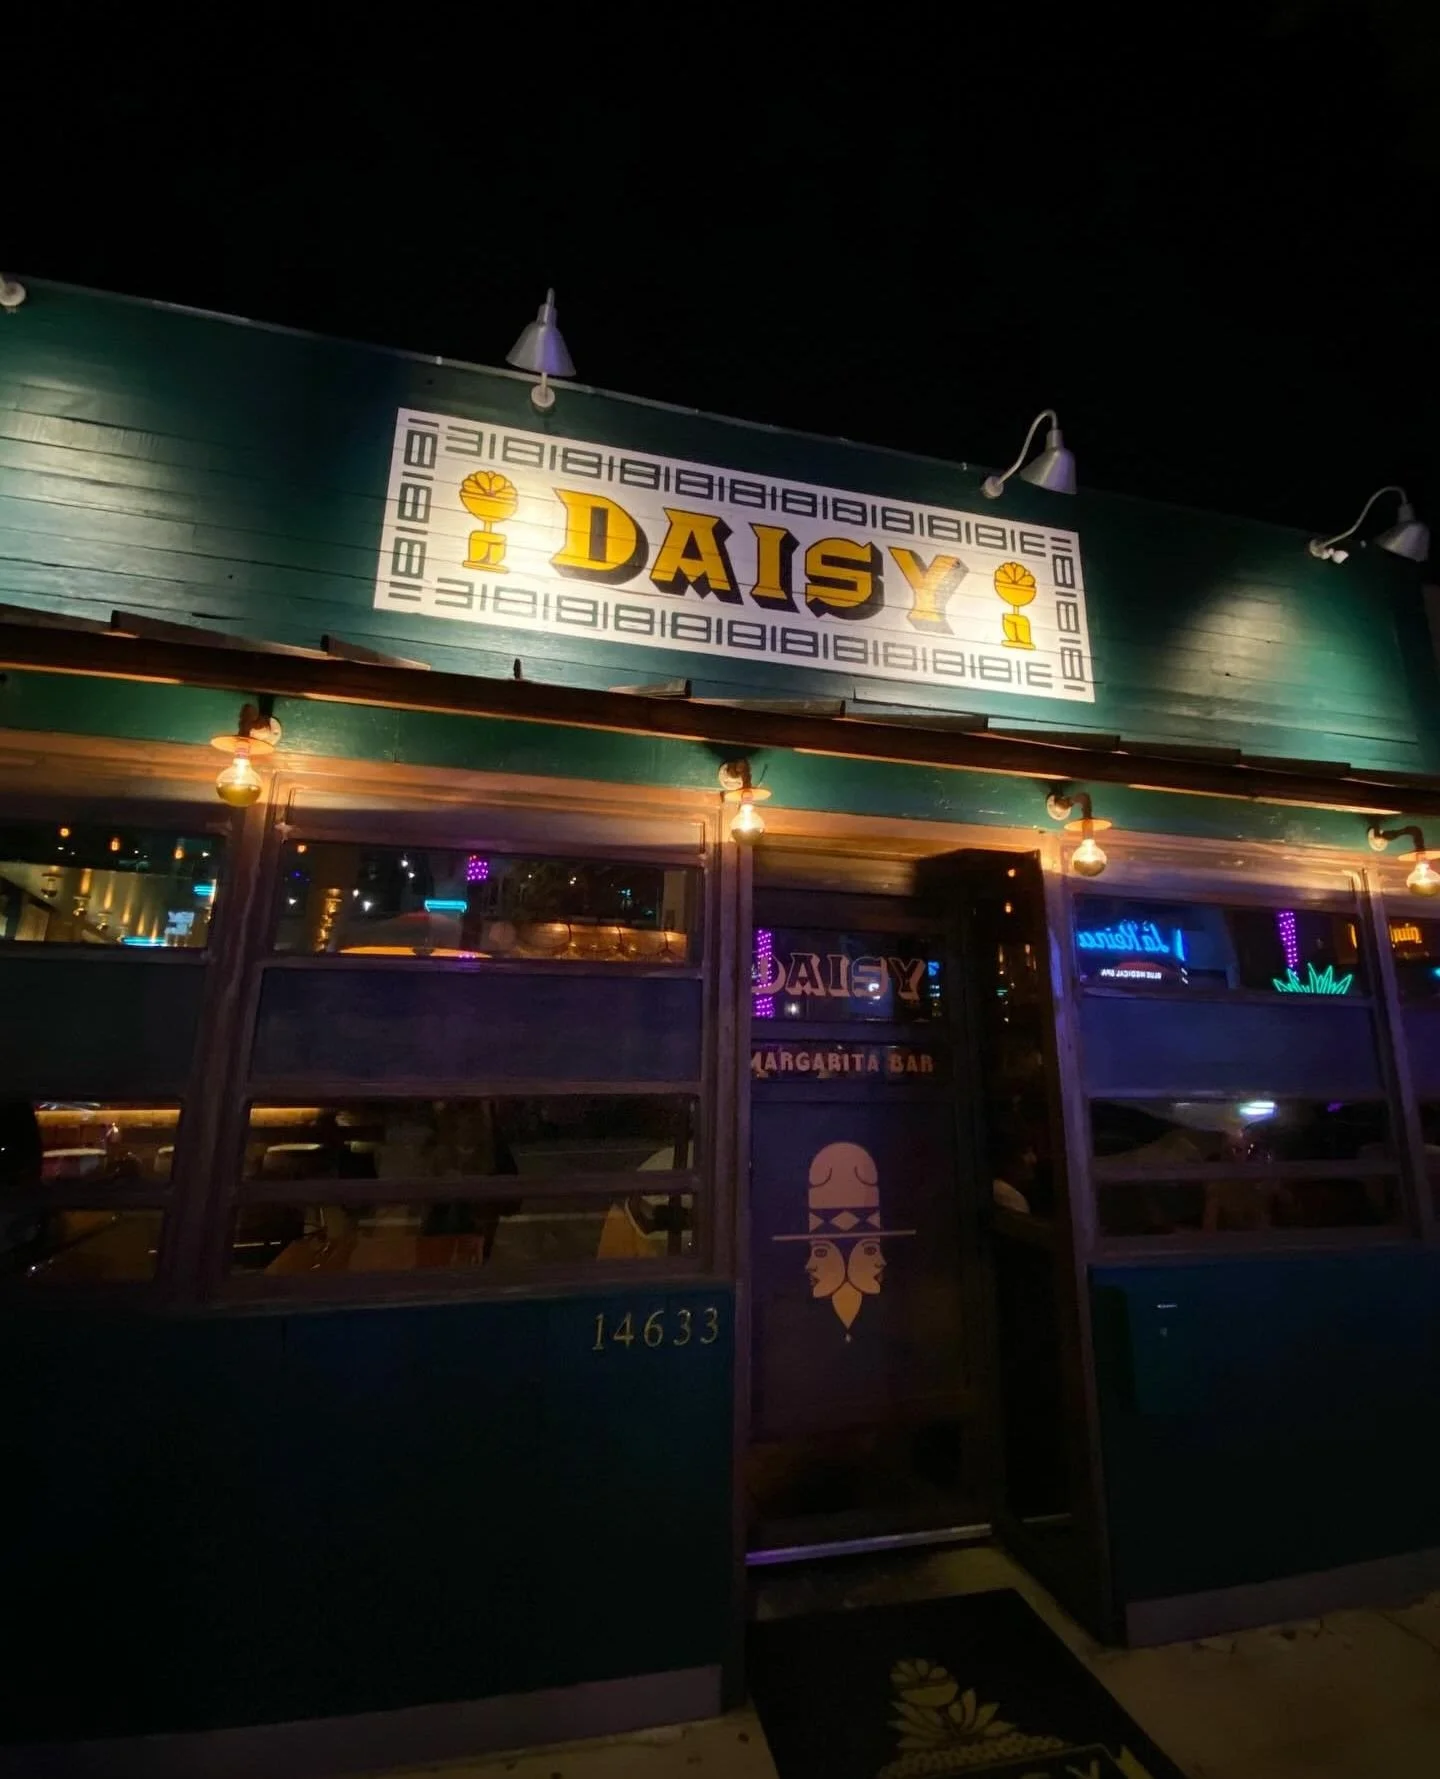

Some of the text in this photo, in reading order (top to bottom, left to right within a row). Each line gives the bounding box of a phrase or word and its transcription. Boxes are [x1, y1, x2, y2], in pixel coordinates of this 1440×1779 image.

[550, 488, 970, 635] DAISY
[751, 950, 926, 1001] DAISY
[889, 1052, 934, 1073] BAR
[592, 1307, 719, 1351] 14633
